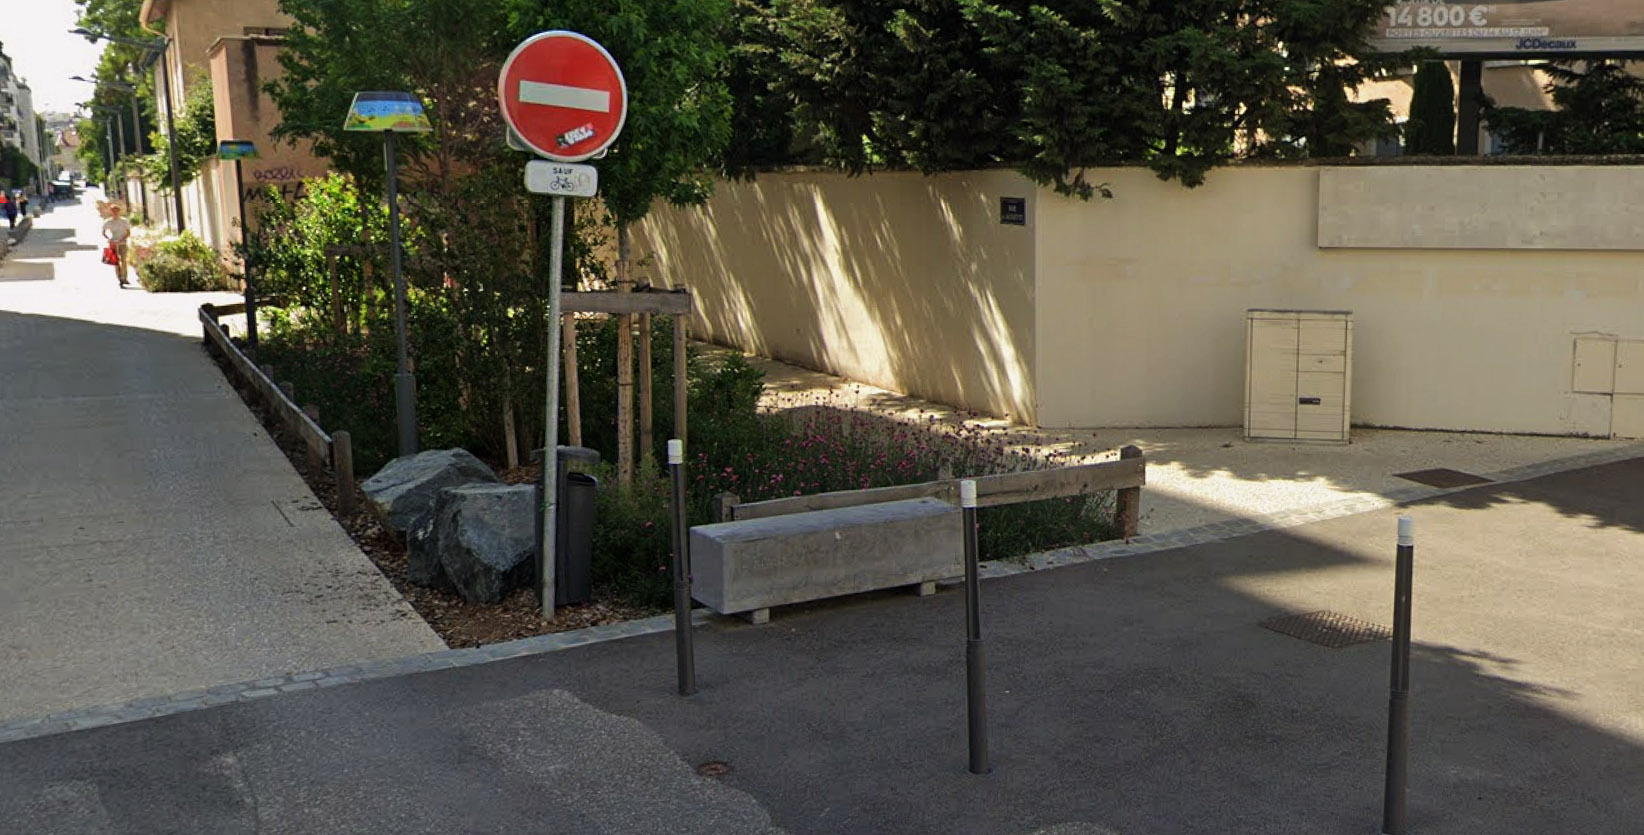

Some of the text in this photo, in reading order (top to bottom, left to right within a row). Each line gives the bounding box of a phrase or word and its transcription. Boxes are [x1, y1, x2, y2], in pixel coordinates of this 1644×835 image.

[1416, 6, 1466, 27] 800
[1468, 5, 1488, 27] €
[1515, 38, 1577, 50] JCDecaux
[552, 166, 573, 175] SAUF
